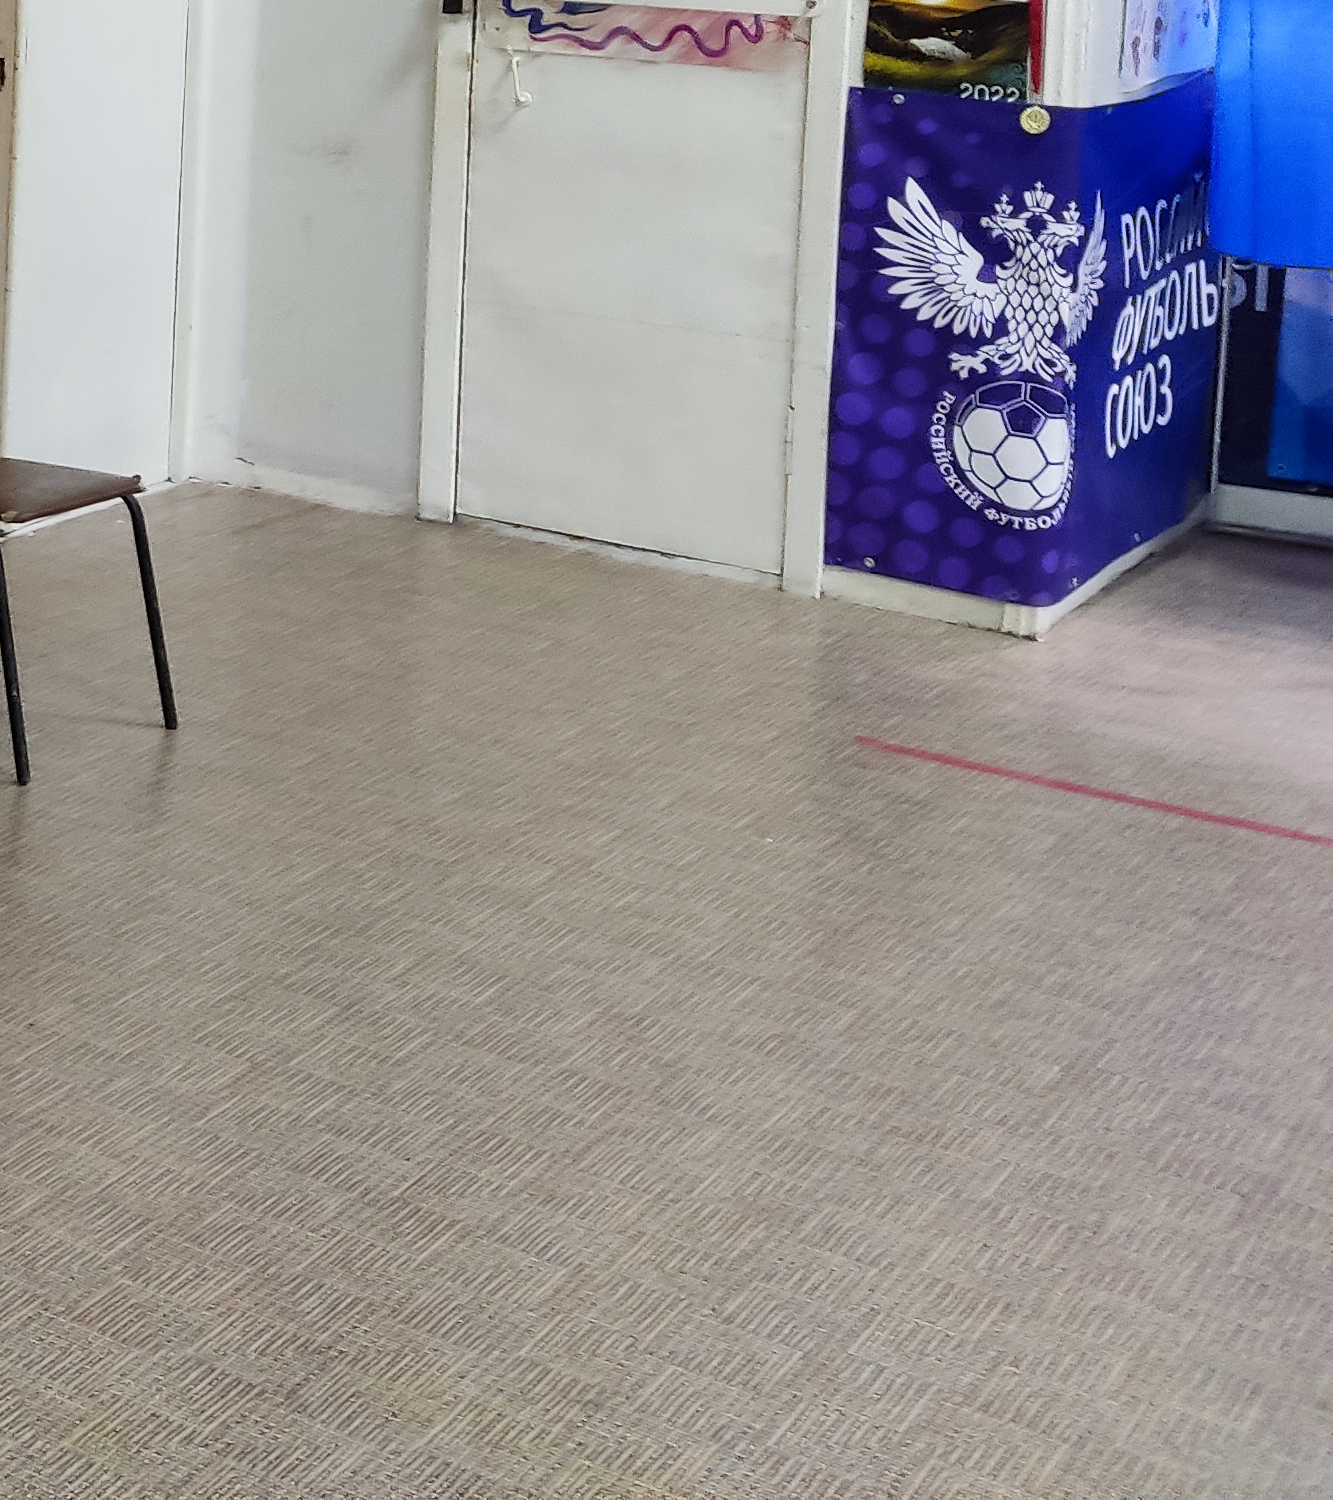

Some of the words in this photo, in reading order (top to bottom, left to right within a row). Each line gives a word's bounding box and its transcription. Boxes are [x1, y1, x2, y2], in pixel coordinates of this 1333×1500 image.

[959, 82, 1021, 103] 2022
[1112, 257, 1222, 372] ФУТБОЛЬ
[1105, 354, 1173, 460] СОЮЗ
